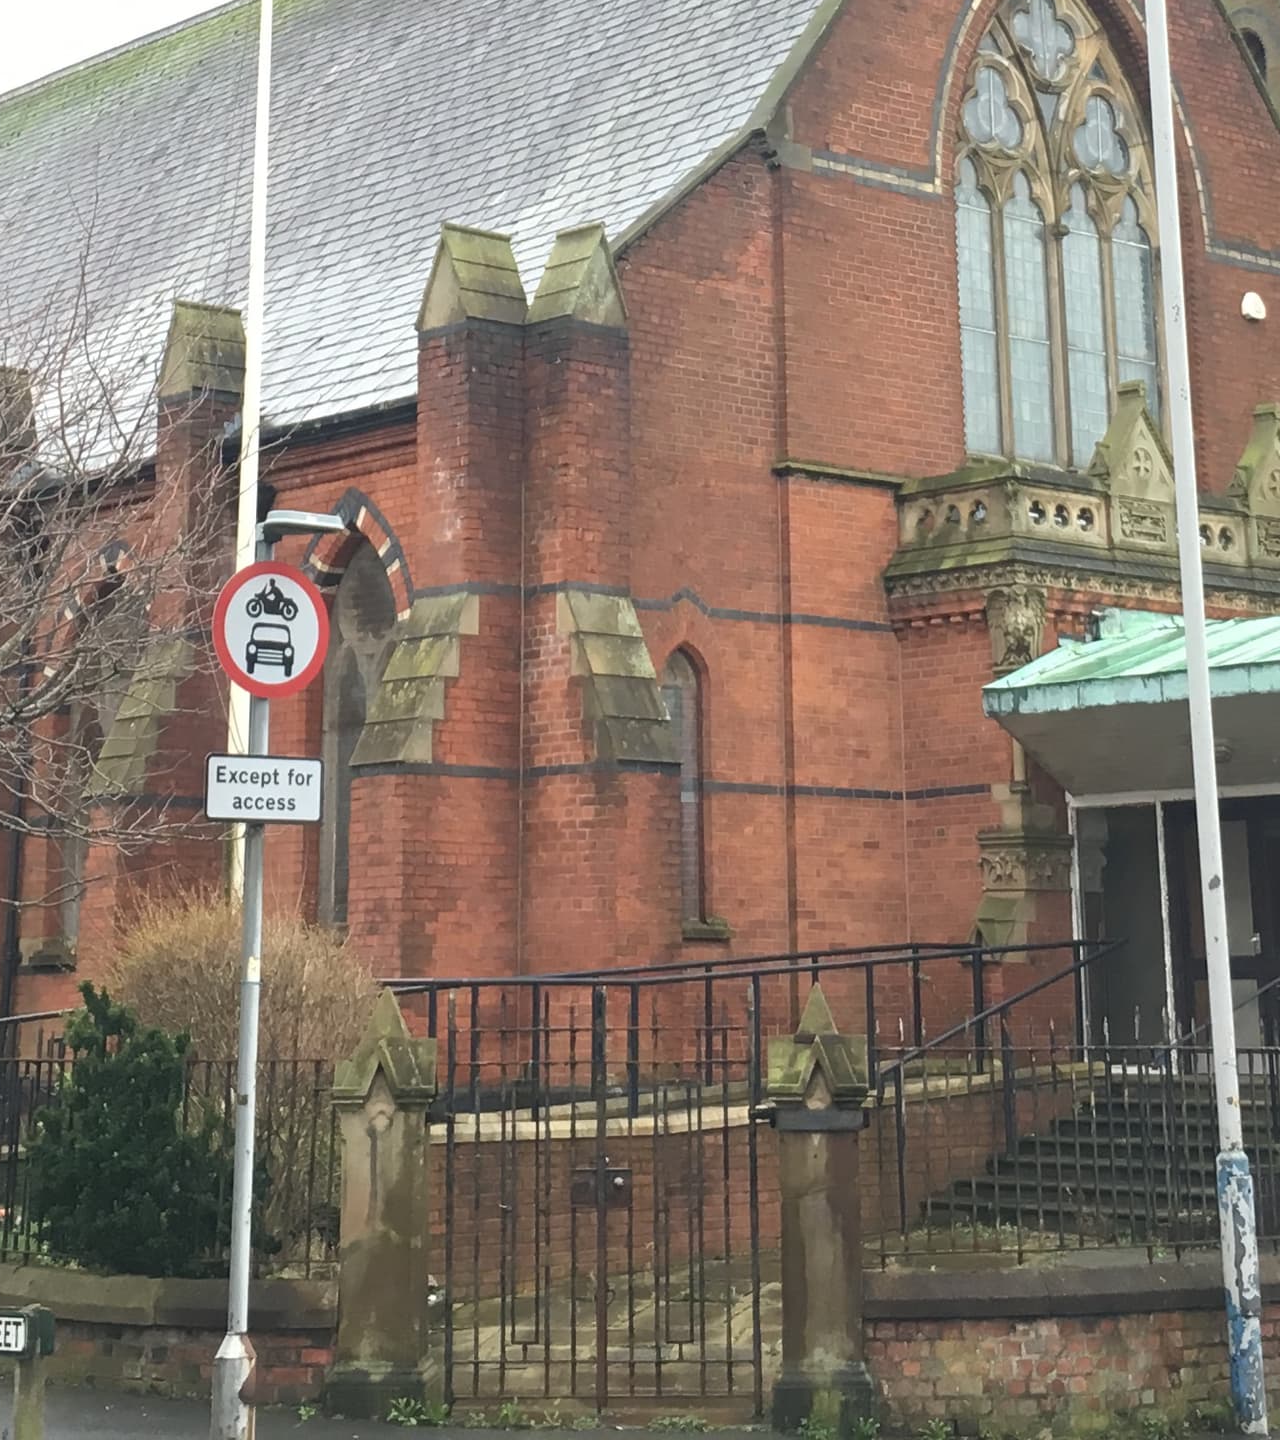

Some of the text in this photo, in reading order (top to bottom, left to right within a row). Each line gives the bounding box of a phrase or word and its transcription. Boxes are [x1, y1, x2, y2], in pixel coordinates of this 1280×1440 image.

[216, 765, 313, 788] Except for
[232, 795, 296, 811] access
